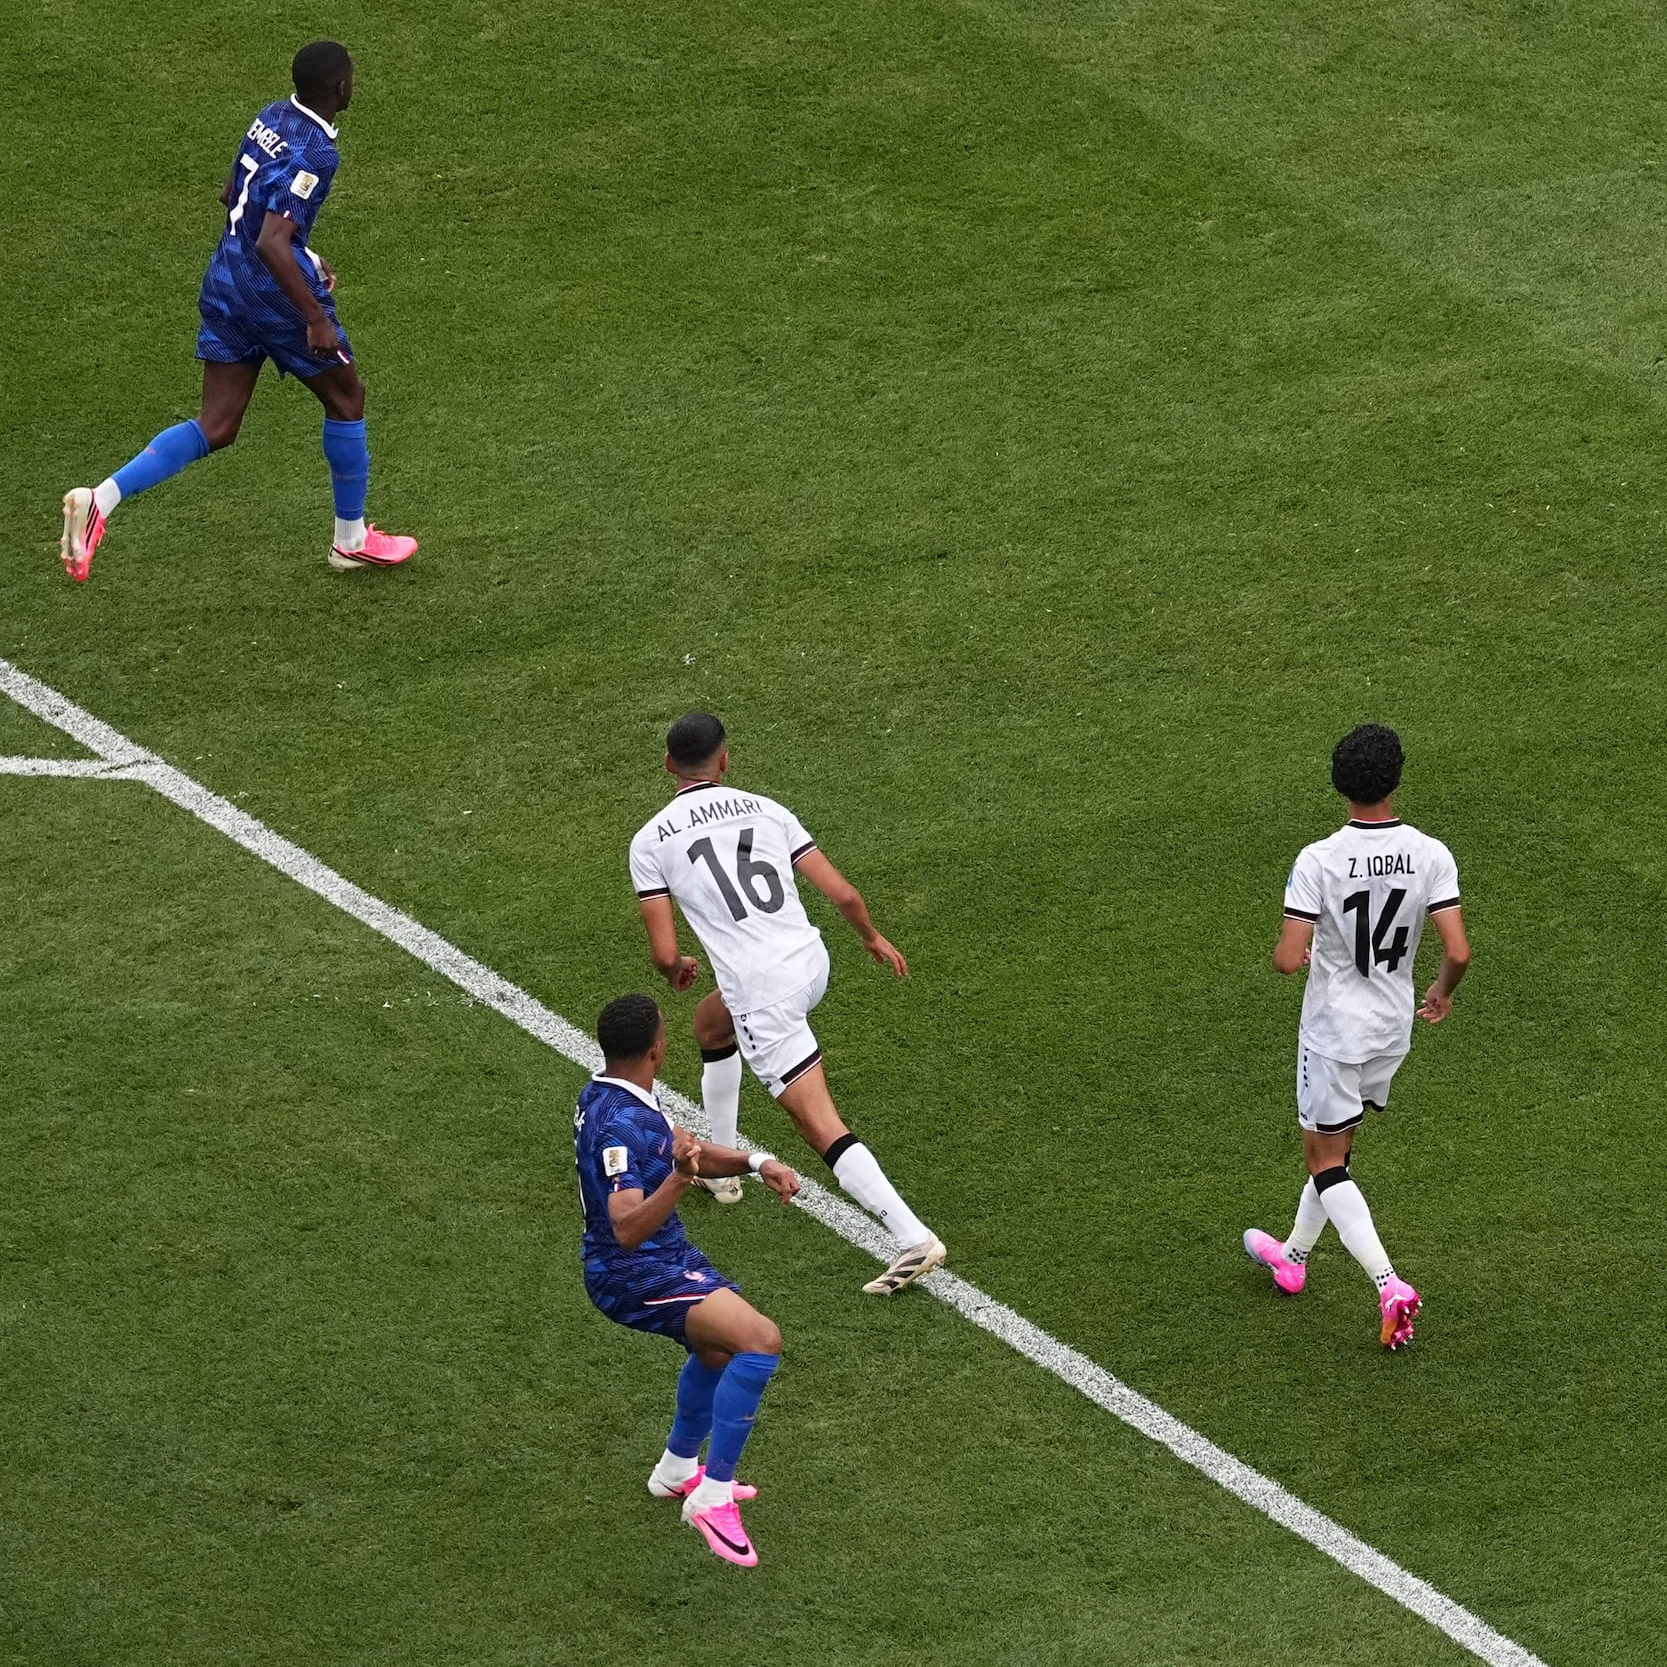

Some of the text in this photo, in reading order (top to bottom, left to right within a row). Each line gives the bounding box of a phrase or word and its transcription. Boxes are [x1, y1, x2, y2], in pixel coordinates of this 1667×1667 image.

[229, 153, 259, 236] 7
[657, 819, 682, 842] AL
[1347, 853, 1416, 879] Z. IQBAL
[686, 827, 785, 922] 16
[1342, 888, 1409, 978] 14
